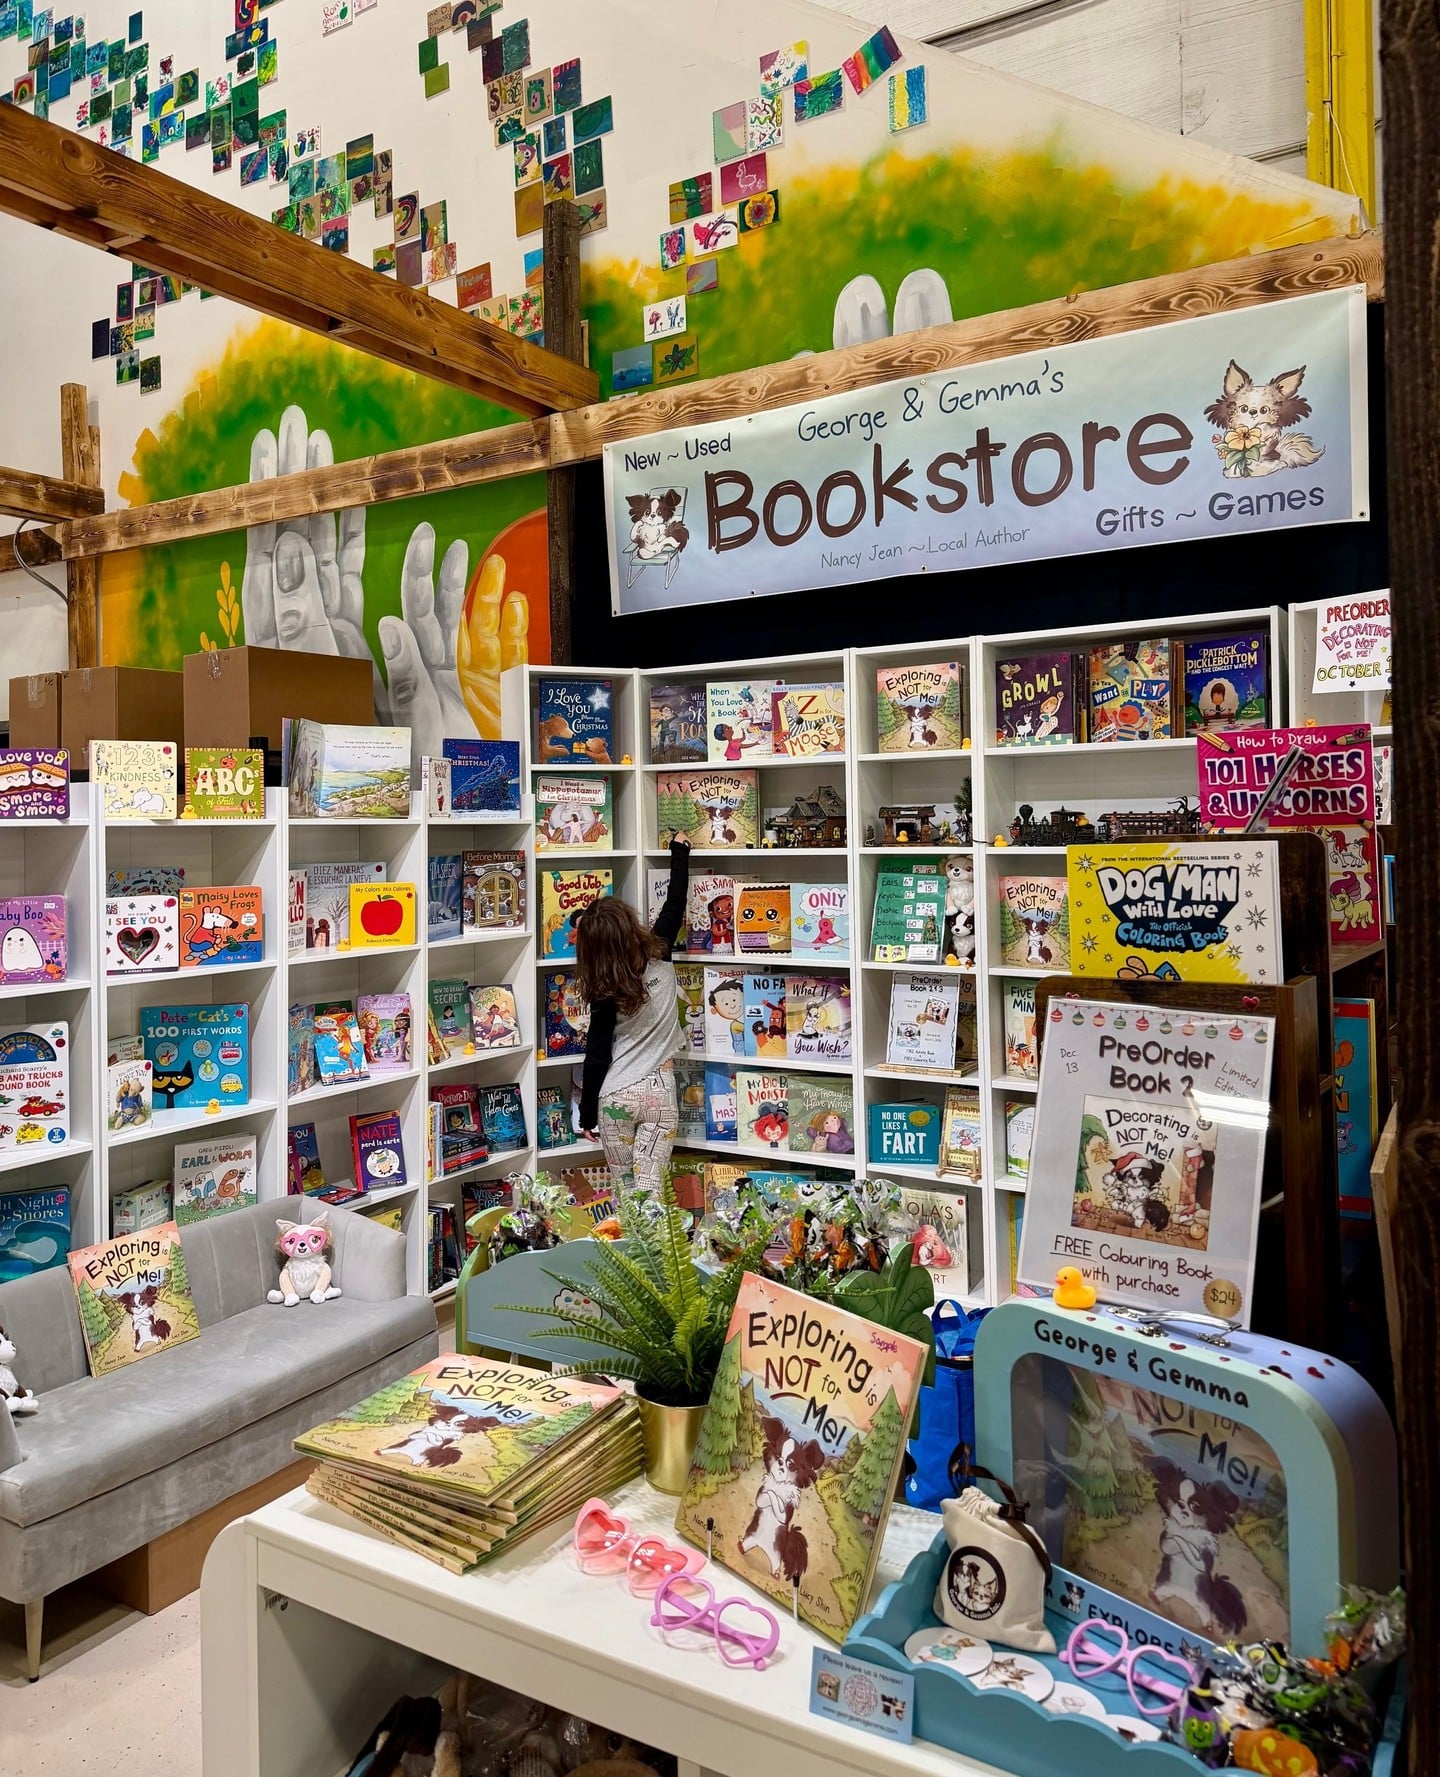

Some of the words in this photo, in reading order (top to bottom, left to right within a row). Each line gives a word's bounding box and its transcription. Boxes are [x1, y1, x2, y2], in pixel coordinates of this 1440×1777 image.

[798, 410, 887, 441] George
[902, 387, 924, 421] &
[939, 359, 1064, 414] Gemma's
[625, 452, 661, 471] New
[685, 432, 731, 460] Used
[705, 413, 1193, 554] Bookstore
[1096, 505, 1164, 536] Gifts
[1209, 487, 1325, 520] Games
[821, 552, 861, 569] Nancy
[869, 544, 902, 562] Jean
[975, 528, 1031, 547] Author
[1327, 599, 1391, 623] PREORDER
[1322, 623, 1391, 650] DECORATING
[1355, 638, 1377, 648] NOT
[1203, 646, 1237, 658] PATRICK
[1187, 652, 1257, 672] PICKLEBOTTOM
[886, 670, 941, 690] Exploring
[1317, 662, 1381, 681] OCTOBER
[898, 683, 921, 699] NOT
[1002, 668, 1062, 707] GROWL
[1095, 689, 1118, 703] Want
[1134, 681, 1166, 697] PLAY?
[554, 688, 582, 705] Love
[711, 698, 724, 706] You
[798, 695, 818, 715] Z
[920, 693, 938, 703] Me!
[718, 709, 736, 717] Book
[572, 719, 608, 733] CHRISTMAS
[790, 727, 835, 754] MOOSE
[1237, 735, 1265, 748] How
[1270, 732, 1283, 747] to
[1289, 733, 1327, 745] Draw
[1205, 757, 1247, 785] 101
[1253, 750, 1364, 785] HRSES
[690, 775, 740, 792] Exploring
[701, 786, 721, 800] NOT
[720, 796, 737, 805] Me!
[1208, 794, 1229, 816] &
[1228, 784, 1367, 818] UNCORNS
[15, 805, 66, 817] S'more
[467, 853, 492, 861] Before
[345, 876, 352, 884] LA
[554, 876, 581, 892] Good
[1097, 864, 1166, 905] DOG
[1171, 864, 1239, 902] MAN
[233, 891, 258, 899] Loves
[559, 889, 600, 910] George!
[1007, 882, 1056, 900] Exploring
[230, 900, 255, 910] Frogs
[808, 892, 846, 908] ONLY
[1017, 896, 1038, 910] NOT
[25, 906, 43, 919] Boo
[108, 918, 112, 926] I
[116, 917, 136, 925] SEE
[141, 916, 167, 925] YOU
[1037, 906, 1054, 921] Me!
[719, 970, 746, 978] Backup
[912, 976, 942, 984] PreOrder
[753, 979, 769, 989] NO
[793, 982, 817, 997] What
[434, 993, 462, 1004] SECRET
[160, 1011, 188, 1024] Pete
[198, 1010, 229, 1023] Cat's
[147, 1027, 180, 1038] 100
[211, 1026, 242, 1035] WORDS
[794, 1039, 815, 1055] You
[818, 1040, 849, 1054] Wish?
[1060, 1048, 1076, 1058] Dec
[1099, 1035, 1215, 1070] PreOrder
[7, 1074, 25, 1082] AND
[28, 1071, 63, 1080] TRUCKS
[1066, 1062, 1079, 1074] 13
[1221, 1061, 1259, 1089] Limited
[26, 1080, 51, 1088] BOOK
[747, 1079, 761, 1089] MY
[762, 1076, 778, 1089] BIG
[1109, 1065, 1171, 1094] Book
[1214, 1077, 1249, 1099] Edition
[485, 1107, 502, 1118] Helen
[502, 1104, 518, 1116] Comes
[803, 1100, 826, 1111] Have
[882, 1111, 891, 1120] NO
[893, 1112, 906, 1120] ONE
[360, 1123, 398, 1140] NATE
[882, 1122, 901, 1130] LIKES
[1105, 1108, 1190, 1138] Decorating
[1191, 1132, 1199, 1141] is
[882, 1132, 927, 1154] FART
[1116, 1127, 1148, 1143] NOT
[1153, 1129, 1169, 1142] for
[361, 1139, 375, 1149] perd
[1146, 1141, 1175, 1163] Me!
[181, 1156, 211, 1169] EARL
[219, 1150, 252, 1163] WORM
[714, 1168, 745, 1176] LIBRARY
[85, 1239, 160, 1280] Exploring
[1054, 1235, 1093, 1256] FREE
[1099, 1243, 1168, 1277] Colouring
[1177, 1257, 1213, 1281] Book
[106, 1258, 135, 1288] NOT
[138, 1259, 151, 1268] for
[137, 1270, 161, 1285] Me!
[1081, 1266, 1109, 1283] with
[1116, 1274, 1180, 1297] purchase
[1210, 1288, 1236, 1305] $24
[870, 1332, 898, 1354] Sample
[749, 1310, 872, 1394] Exploring
[865, 1383, 877, 1407] is
[1034, 1319, 1117, 1365] George
[1127, 1349, 1138, 1373] &
[1149, 1357, 1249, 1408] Gemma
[436, 1366, 572, 1403] Exploring
[765, 1355, 822, 1393] NOT
[822, 1374, 841, 1400] for
[446, 1383, 515, 1400] NOT
[512, 1392, 532, 1404] for
[483, 1400, 532, 1421] Me!
[801, 1396, 847, 1453] Me!
[1198, 1432, 1261, 1496] Me!
[1084, 1560, 1107, 1581] Nancy
[1109, 1572, 1129, 1590] Jean
[800, 1585, 813, 1603] Lucy
[816, 1596, 830, 1613] Shin
